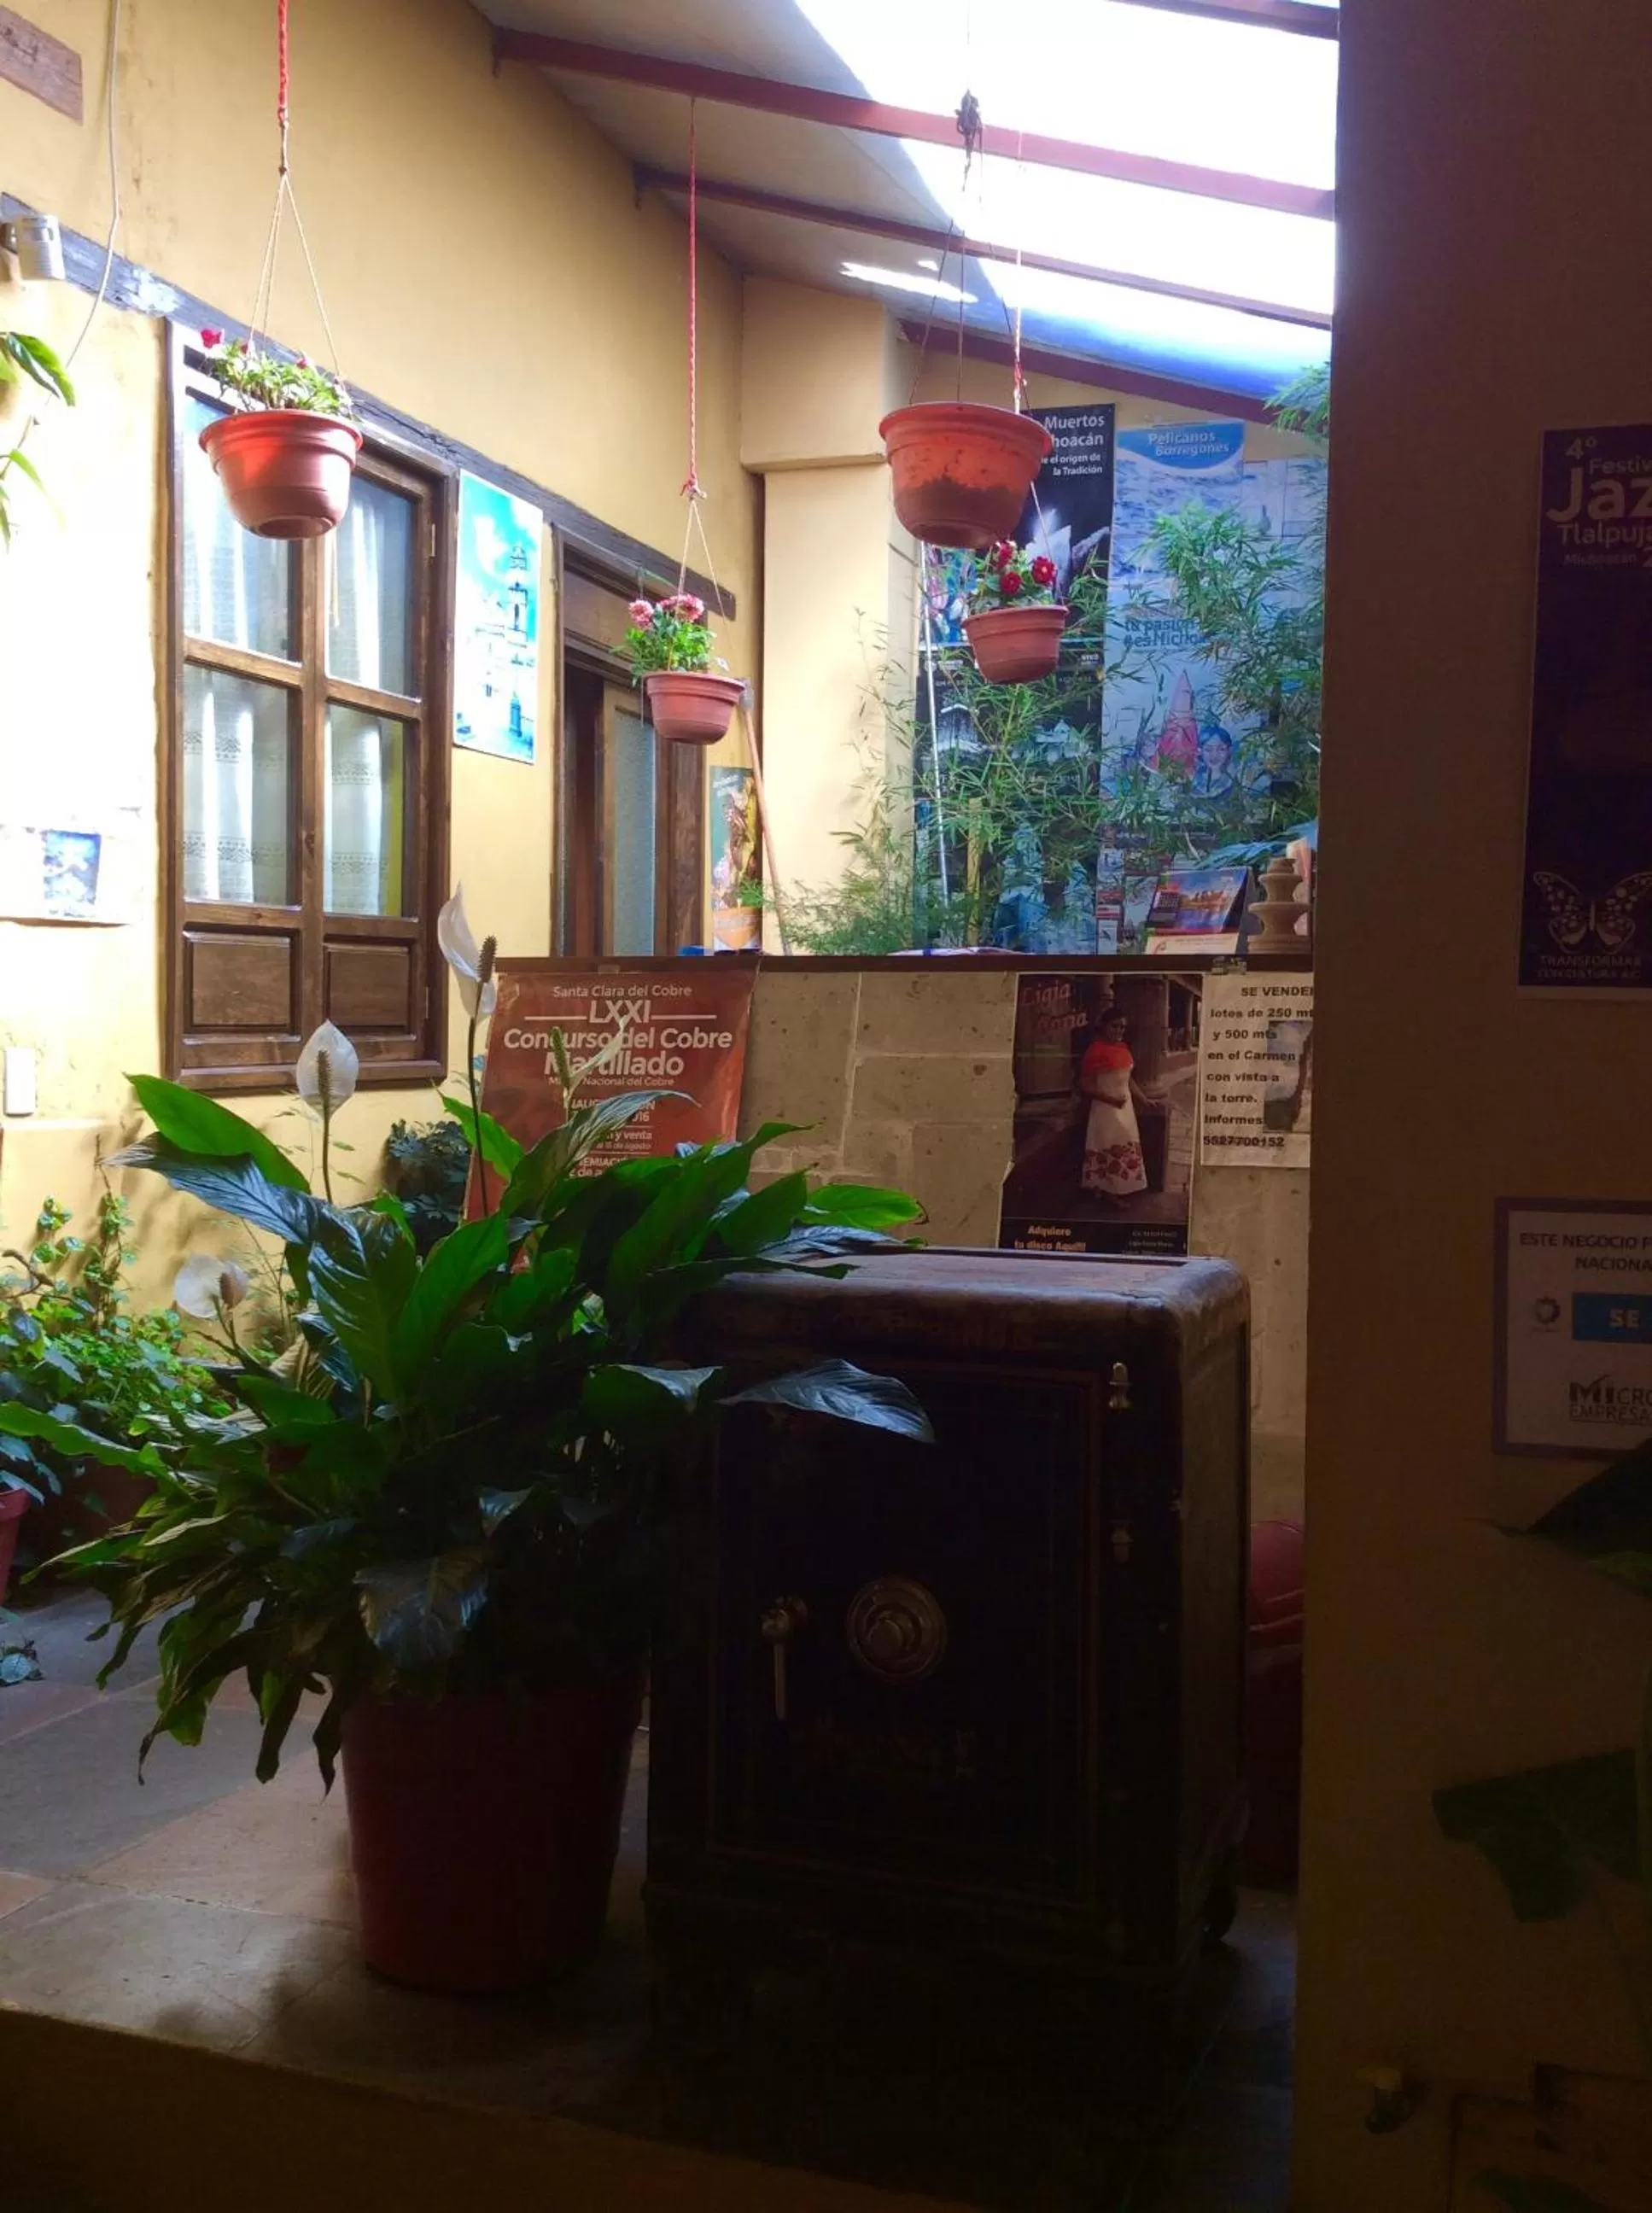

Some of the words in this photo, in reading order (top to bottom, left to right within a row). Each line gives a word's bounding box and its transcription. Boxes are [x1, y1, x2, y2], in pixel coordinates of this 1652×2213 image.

[1045, 415, 1105, 429] Muertos
[1050, 455, 1059, 464] el
[1059, 454, 1088, 465] origen
[1089, 453, 1100, 461] de
[1053, 466, 1061, 476] la
[1062, 464, 1102, 475] Tradición
[554, 986, 589, 997] Santa
[592, 985, 624, 997] Clara
[628, 984, 649, 996] del
[651, 984, 692, 996] Cobre
[1241, 986, 1257, 996] SE
[589, 1000, 651, 1023] LXXI
[1210, 1008, 1243, 1018] lotes
[1247, 1008, 1264, 1018] de
[1267, 1007, 1292, 1018] 250
[622, 1027, 655, 1048] del
[661, 1027, 733, 1048] Cobre
[1212, 1031, 1220, 1041] y
[1225, 1029, 1248, 1039] 500
[1207, 1051, 1223, 1060] en
[1228, 1050, 1240, 1060] el
[1244, 1050, 1296, 1061] Carmen
[544, 1050, 685, 1076] Matillado
[583, 1077, 626, 1086] Nacional
[628, 1077, 645, 1086] del
[646, 1077, 674, 1086] Cobre
[1206, 1072, 1230, 1082] con
[1235, 1072, 1267, 1082] vista
[1205, 1093, 1217, 1102] la
[632, 1111, 650, 1122] 16
[1204, 1113, 1264, 1124] Informes
[615, 1131, 622, 1142] y
[623, 1130, 653, 1140] venta
[1520, 1233, 1557, 1247] ESTE
[1562, 1235, 1637, 1250] NEGOCIO
[1610, 1307, 1641, 1328] SE
